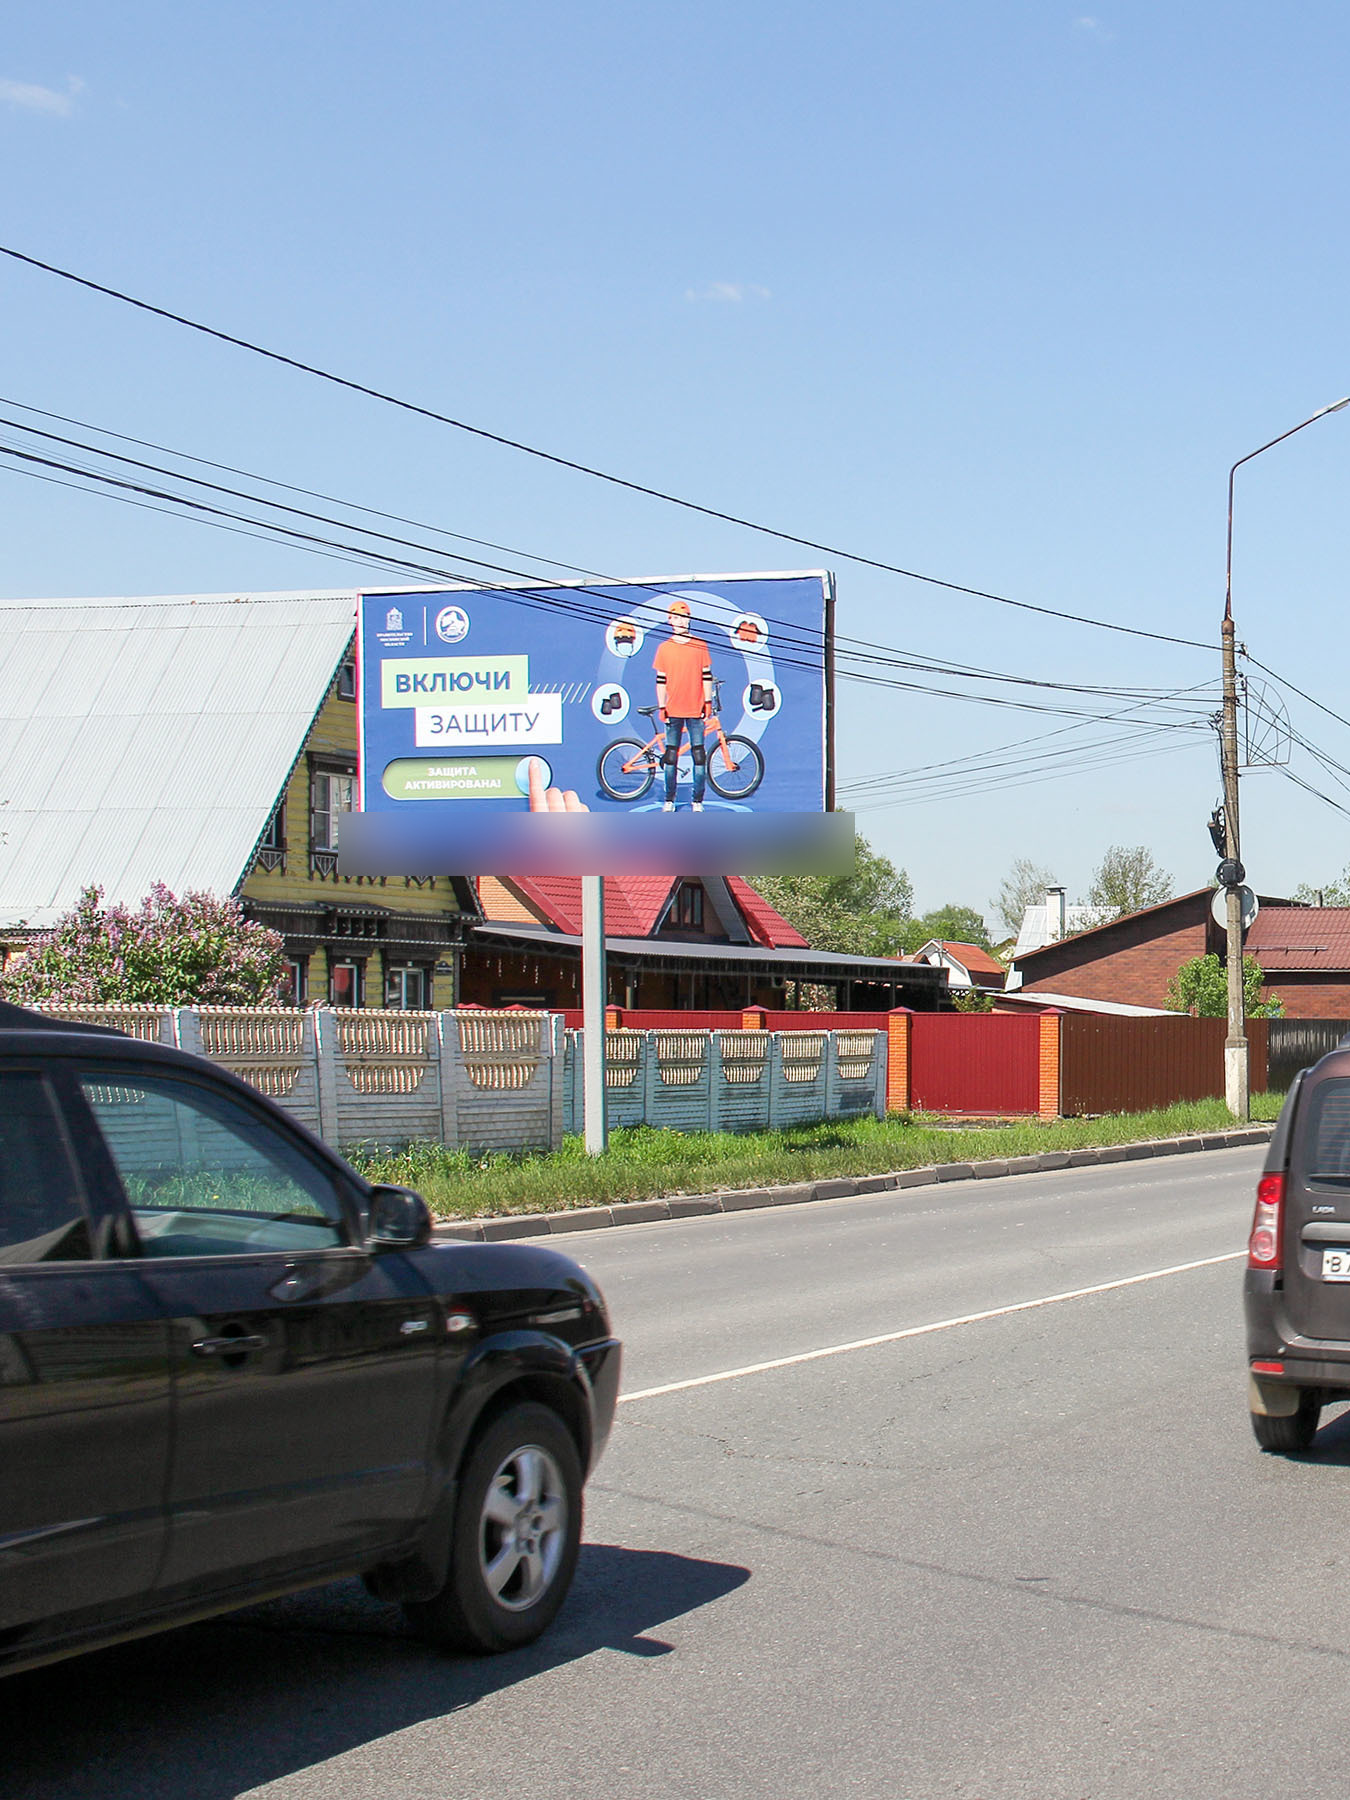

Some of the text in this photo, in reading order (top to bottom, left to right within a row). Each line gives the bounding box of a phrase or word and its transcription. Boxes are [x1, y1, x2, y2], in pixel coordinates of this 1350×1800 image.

[396, 671, 510, 693] ВКЛЮЧИ
[430, 712, 540, 736] ЗАЩИТУ
[428, 766, 477, 777] ЗАЩИТА
[404, 779, 502, 790] АКТИВИРОВАНА!
